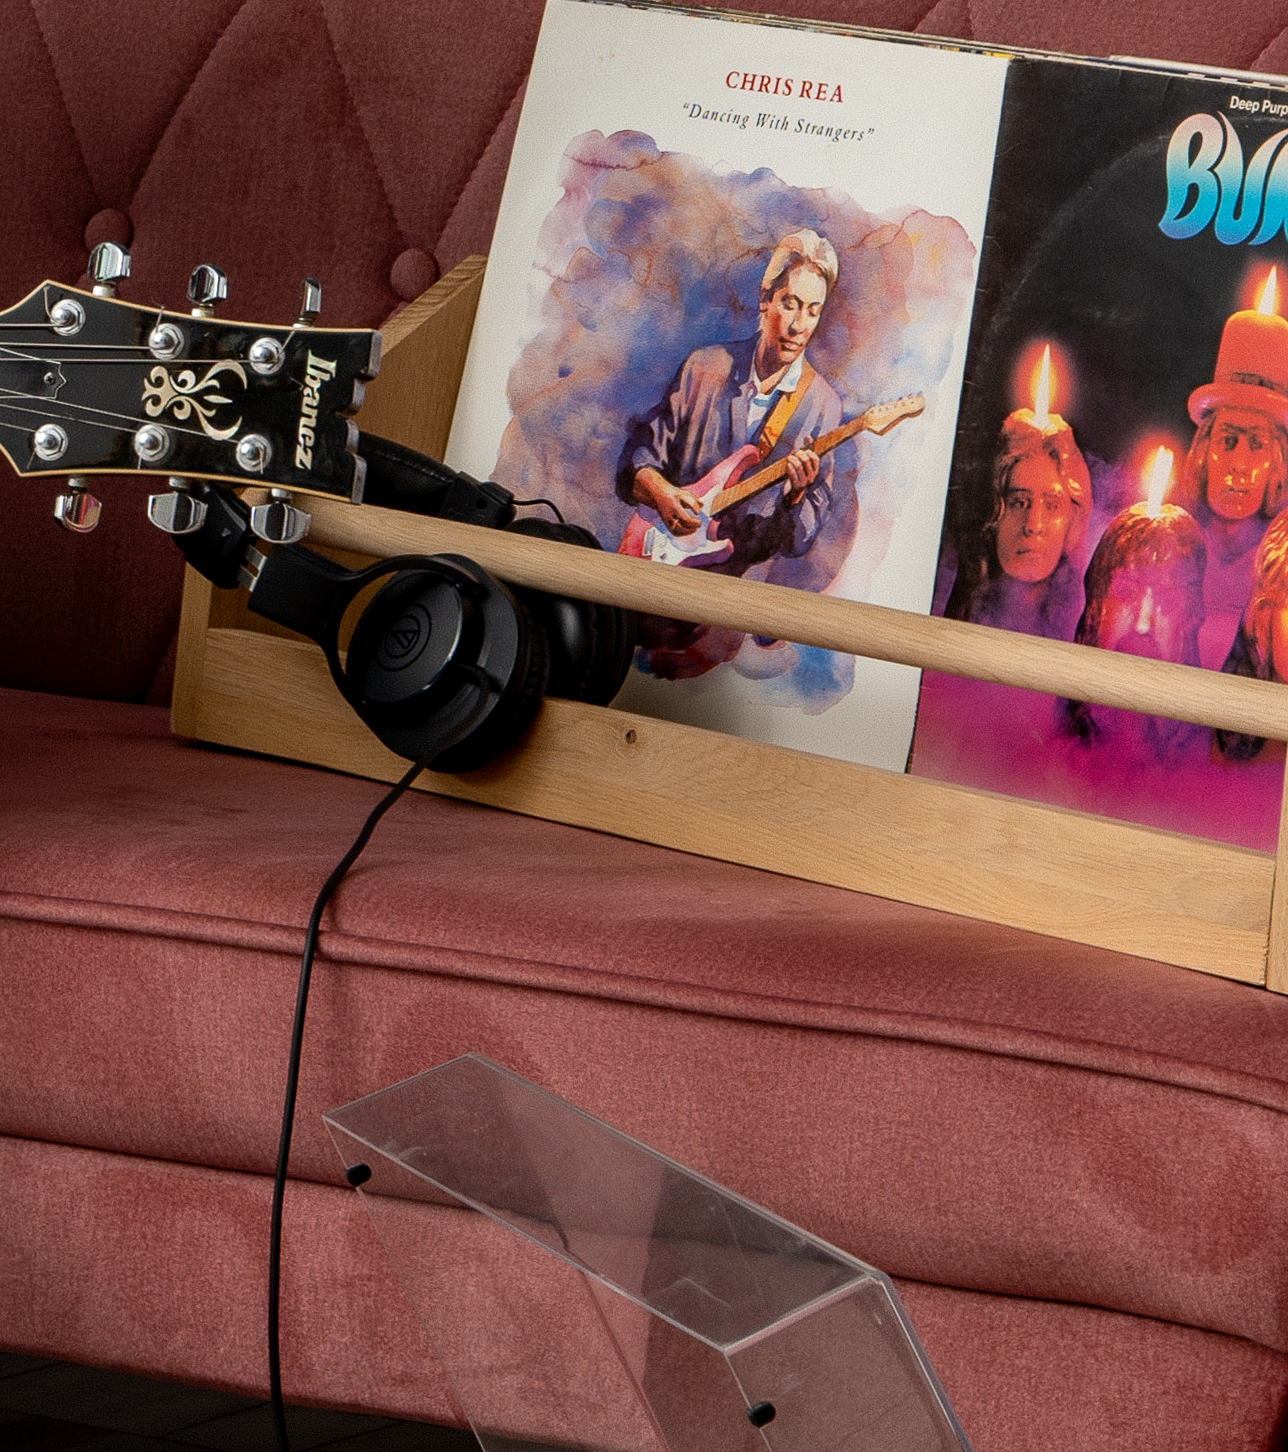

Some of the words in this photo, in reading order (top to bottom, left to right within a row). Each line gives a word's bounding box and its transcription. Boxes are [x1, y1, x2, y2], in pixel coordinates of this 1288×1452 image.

[725, 70, 794, 97] CHRIS
[798, 80, 843, 104] REA
[1229, 95, 1261, 114] Deep
[682, 102, 750, 130] “Dancing
[755, 112, 789, 131] With
[793, 118, 875, 143] Strangers”
[295, 348, 337, 470] Ibanez
